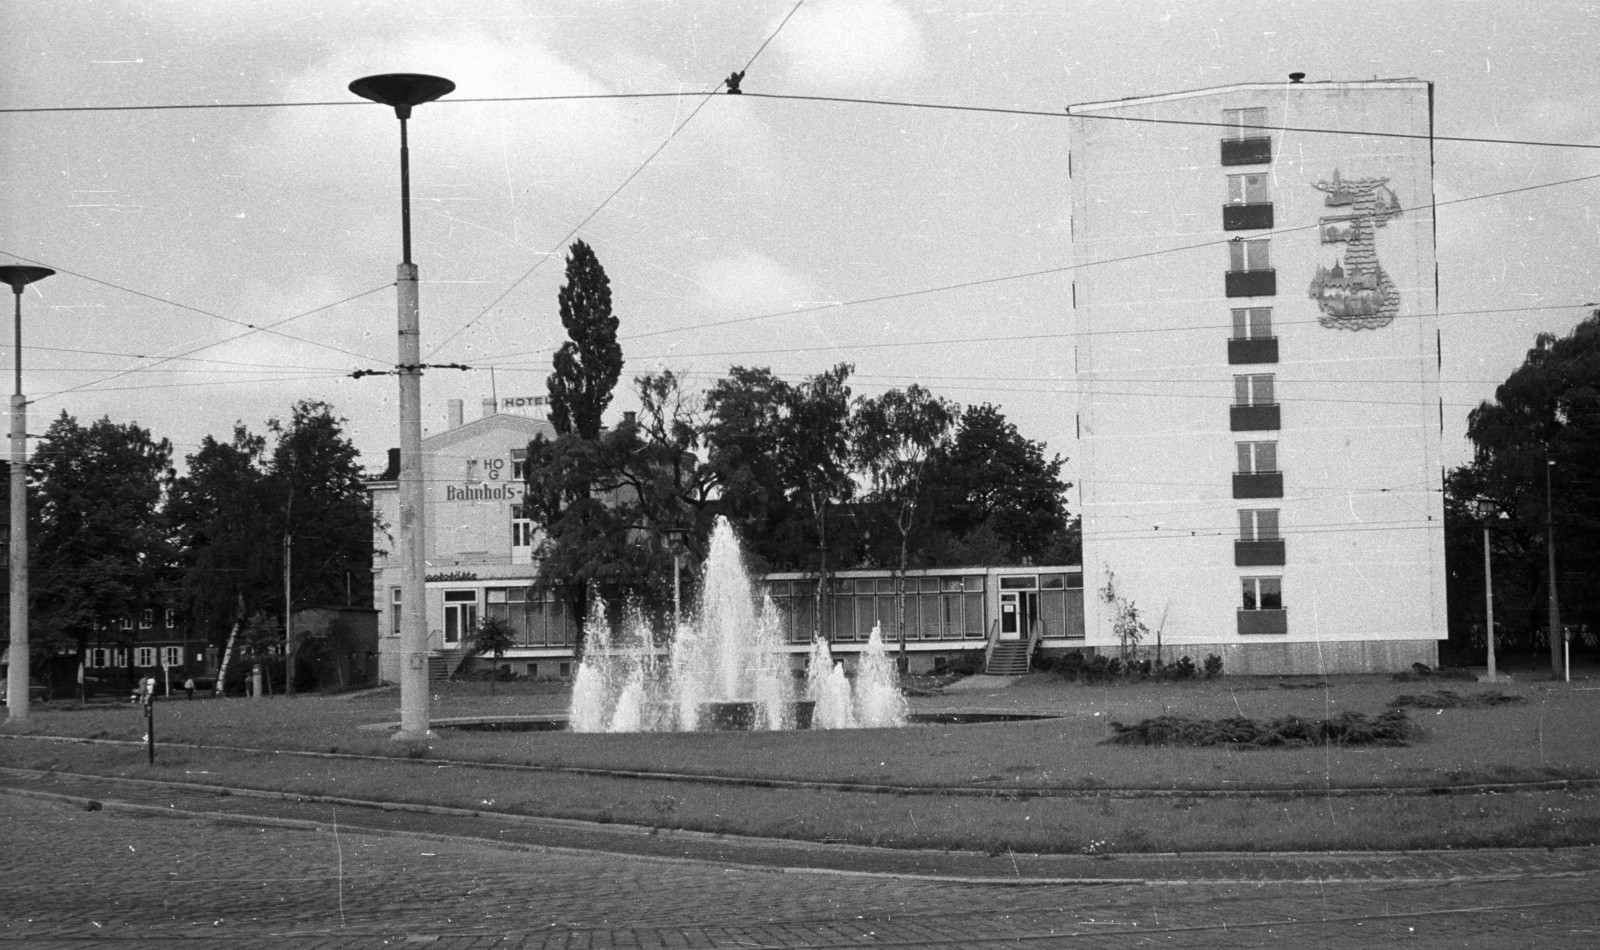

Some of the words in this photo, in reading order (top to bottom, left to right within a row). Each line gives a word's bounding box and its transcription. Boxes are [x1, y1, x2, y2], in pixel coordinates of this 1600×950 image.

[504, 396, 552, 407] HOTEL
[484, 458, 504, 470] HO
[488, 469, 500, 481] G
[446, 483, 523, 501] Bahnhofs-
[424, 570, 478, 582] aststätte
